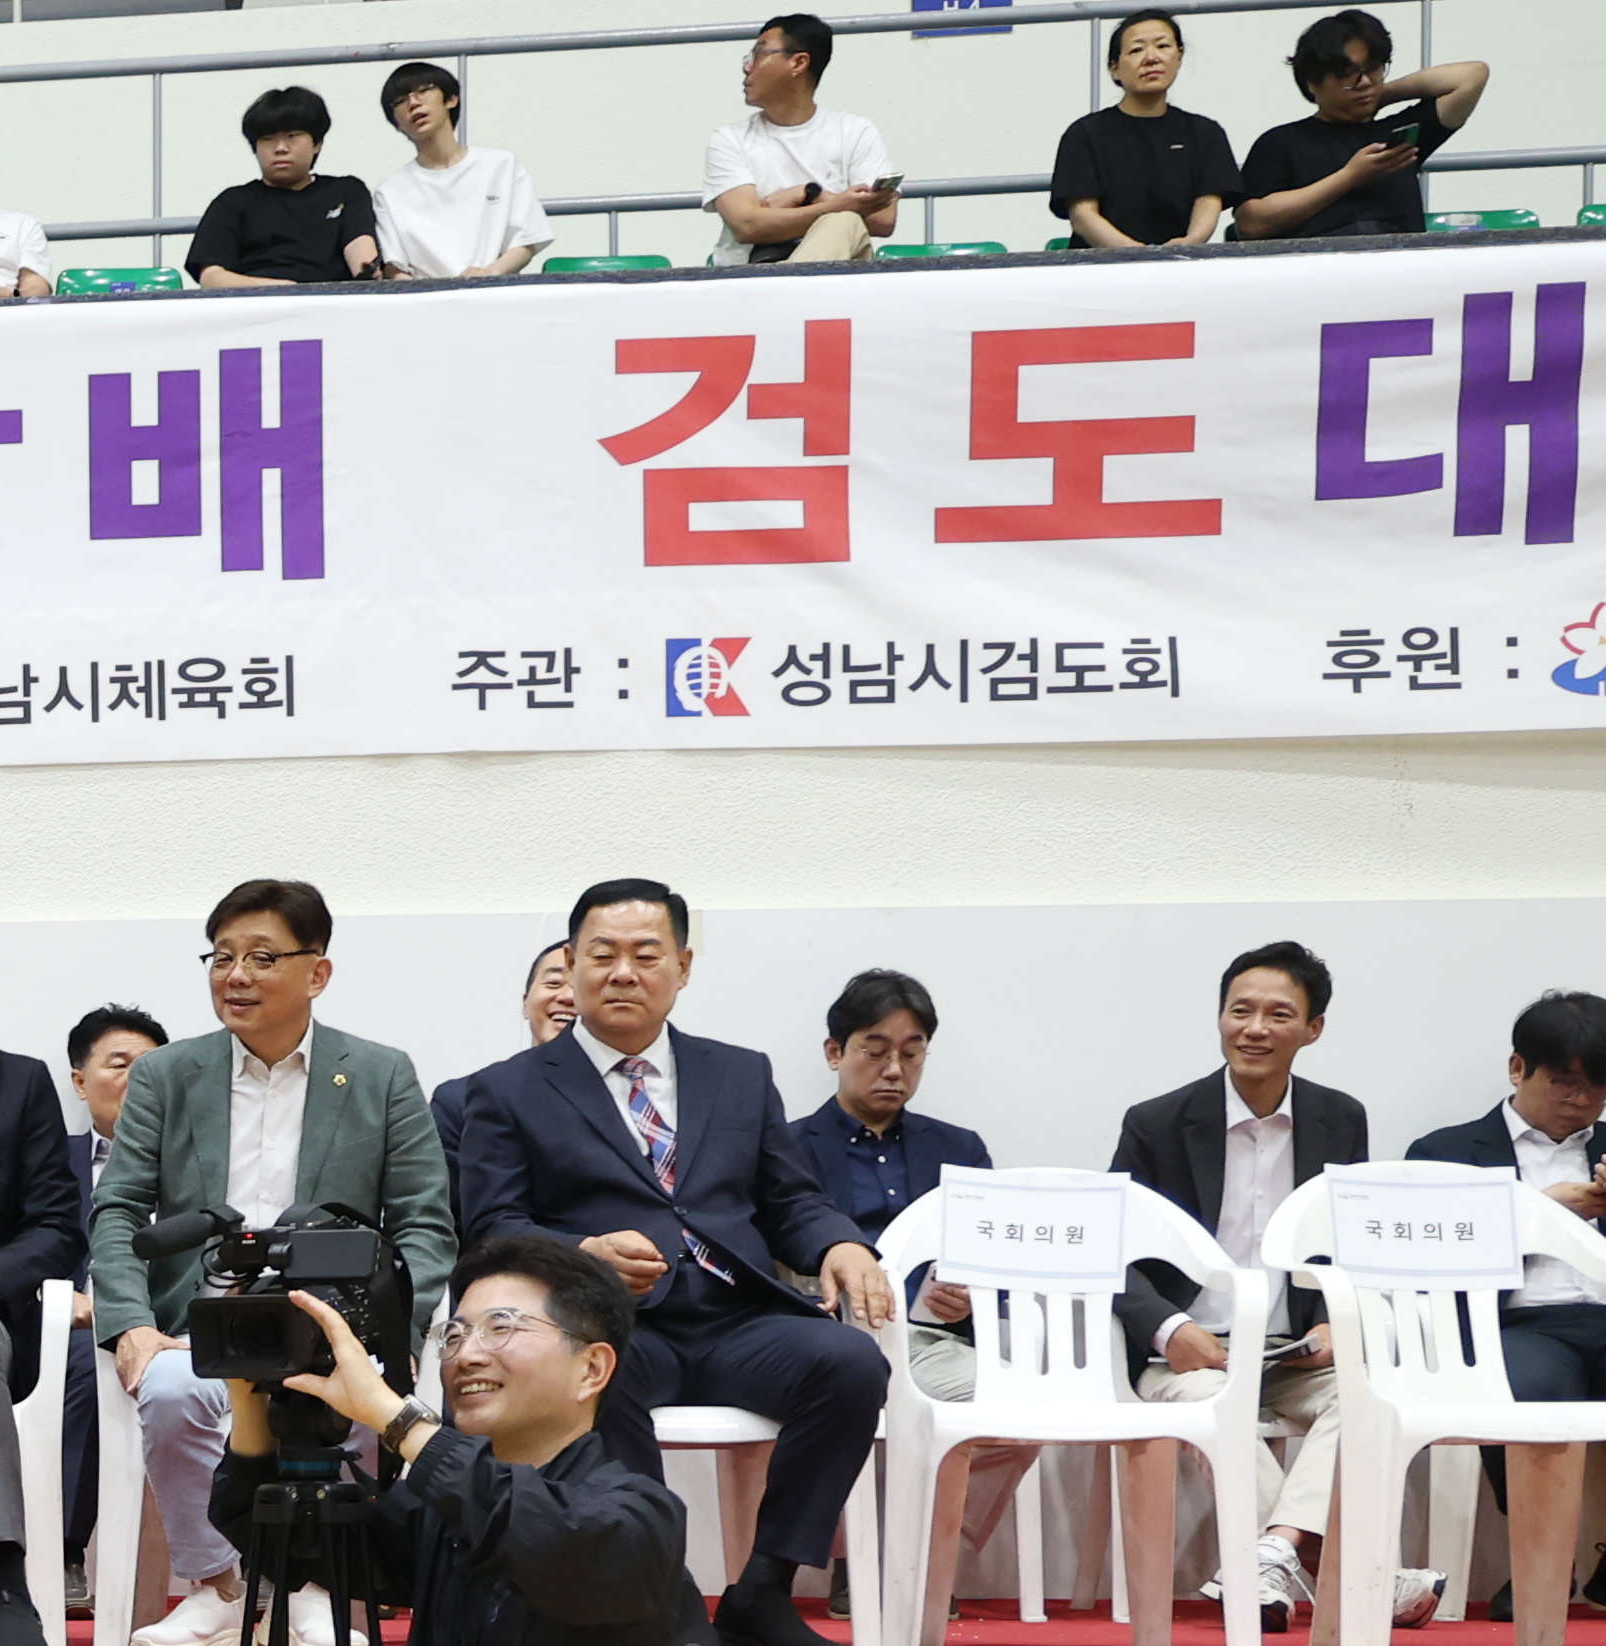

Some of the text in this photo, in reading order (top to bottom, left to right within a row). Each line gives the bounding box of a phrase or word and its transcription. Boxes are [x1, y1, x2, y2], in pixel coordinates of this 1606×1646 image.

[452, 648, 580, 710] 주관
[772, 637, 1179, 706] 성남시검도회
[1323, 627, 1461, 693] 후원
[976, 1220, 1085, 1245] 국회의원
[1365, 1219, 1475, 1242] 국회의원
